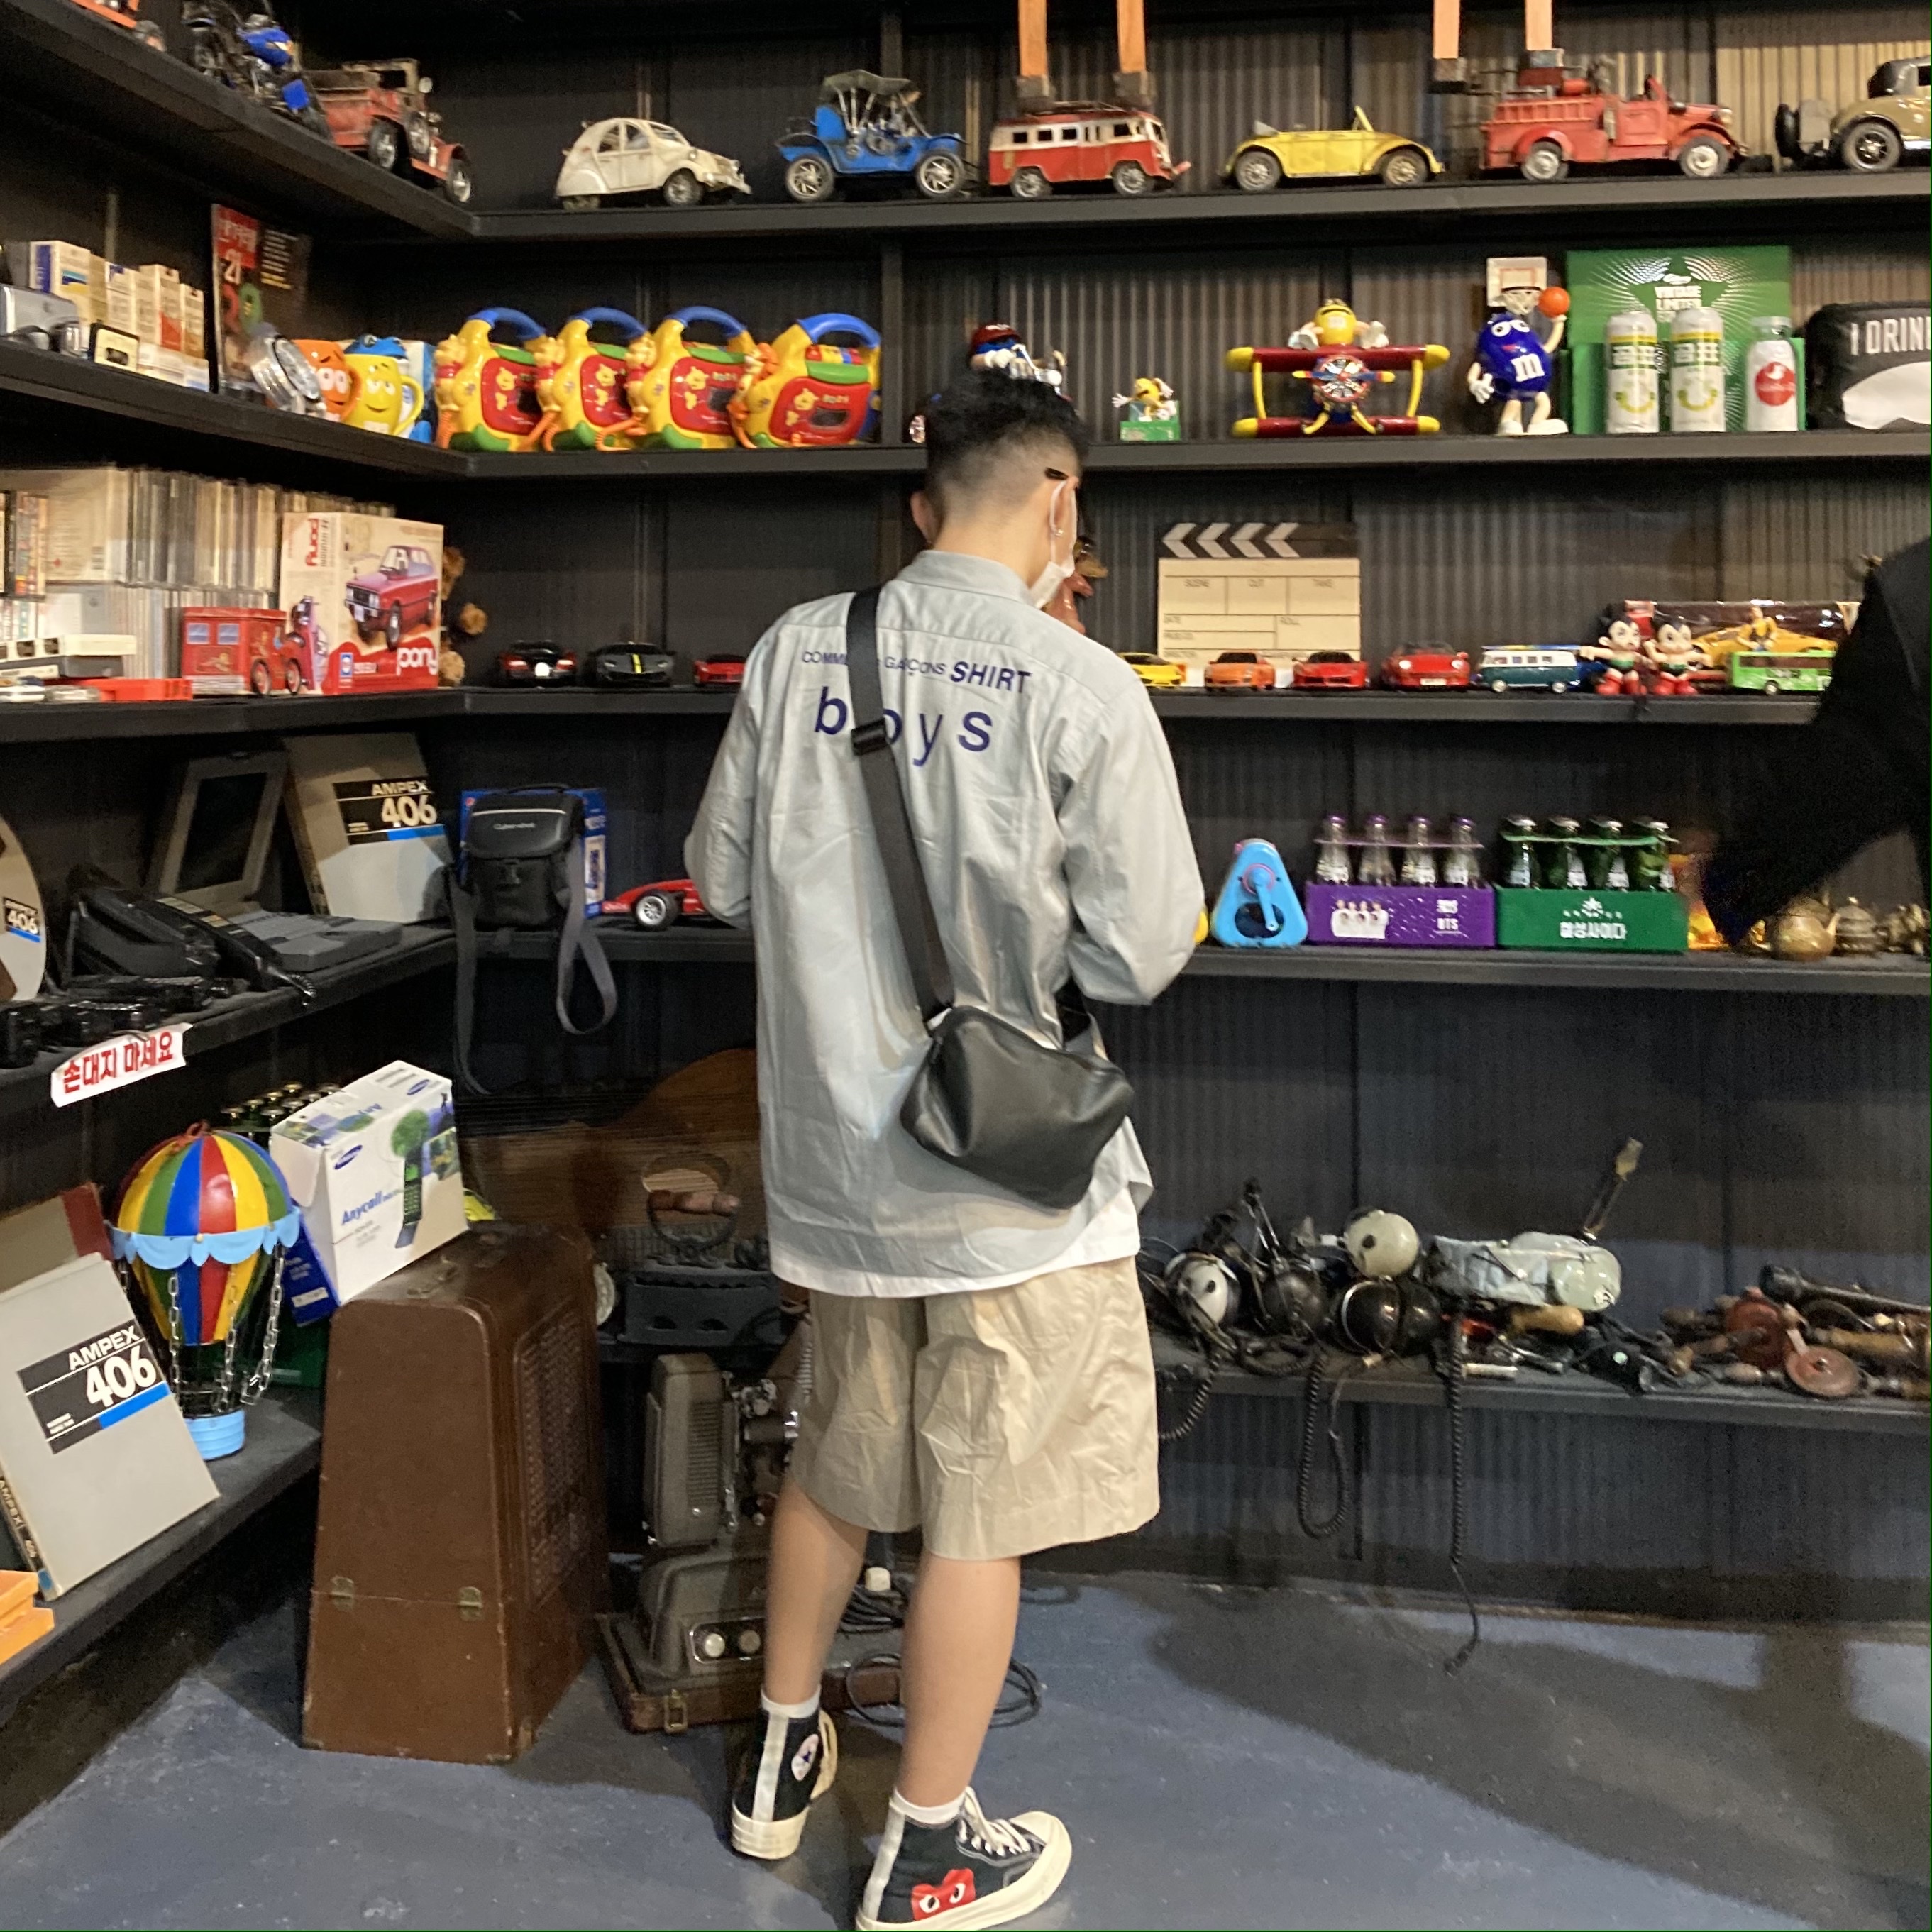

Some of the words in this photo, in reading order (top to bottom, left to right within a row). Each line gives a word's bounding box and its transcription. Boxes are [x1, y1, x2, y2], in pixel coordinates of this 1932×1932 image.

[396, 646, 439, 677] pony
[802, 651, 850, 666] COMM
[950, 661, 1032, 693] SHIRT
[371, 780, 429, 796] AMPEX
[381, 794, 438, 828] 406
[8, 910, 38, 934] 406
[63, 1048, 117, 1093] 손대지
[123, 1031, 174, 1073] 마세요
[341, 1190, 383, 1225] Anycall
[68, 1325, 140, 1371] AMPEX
[86, 1345, 157, 1408] 406
